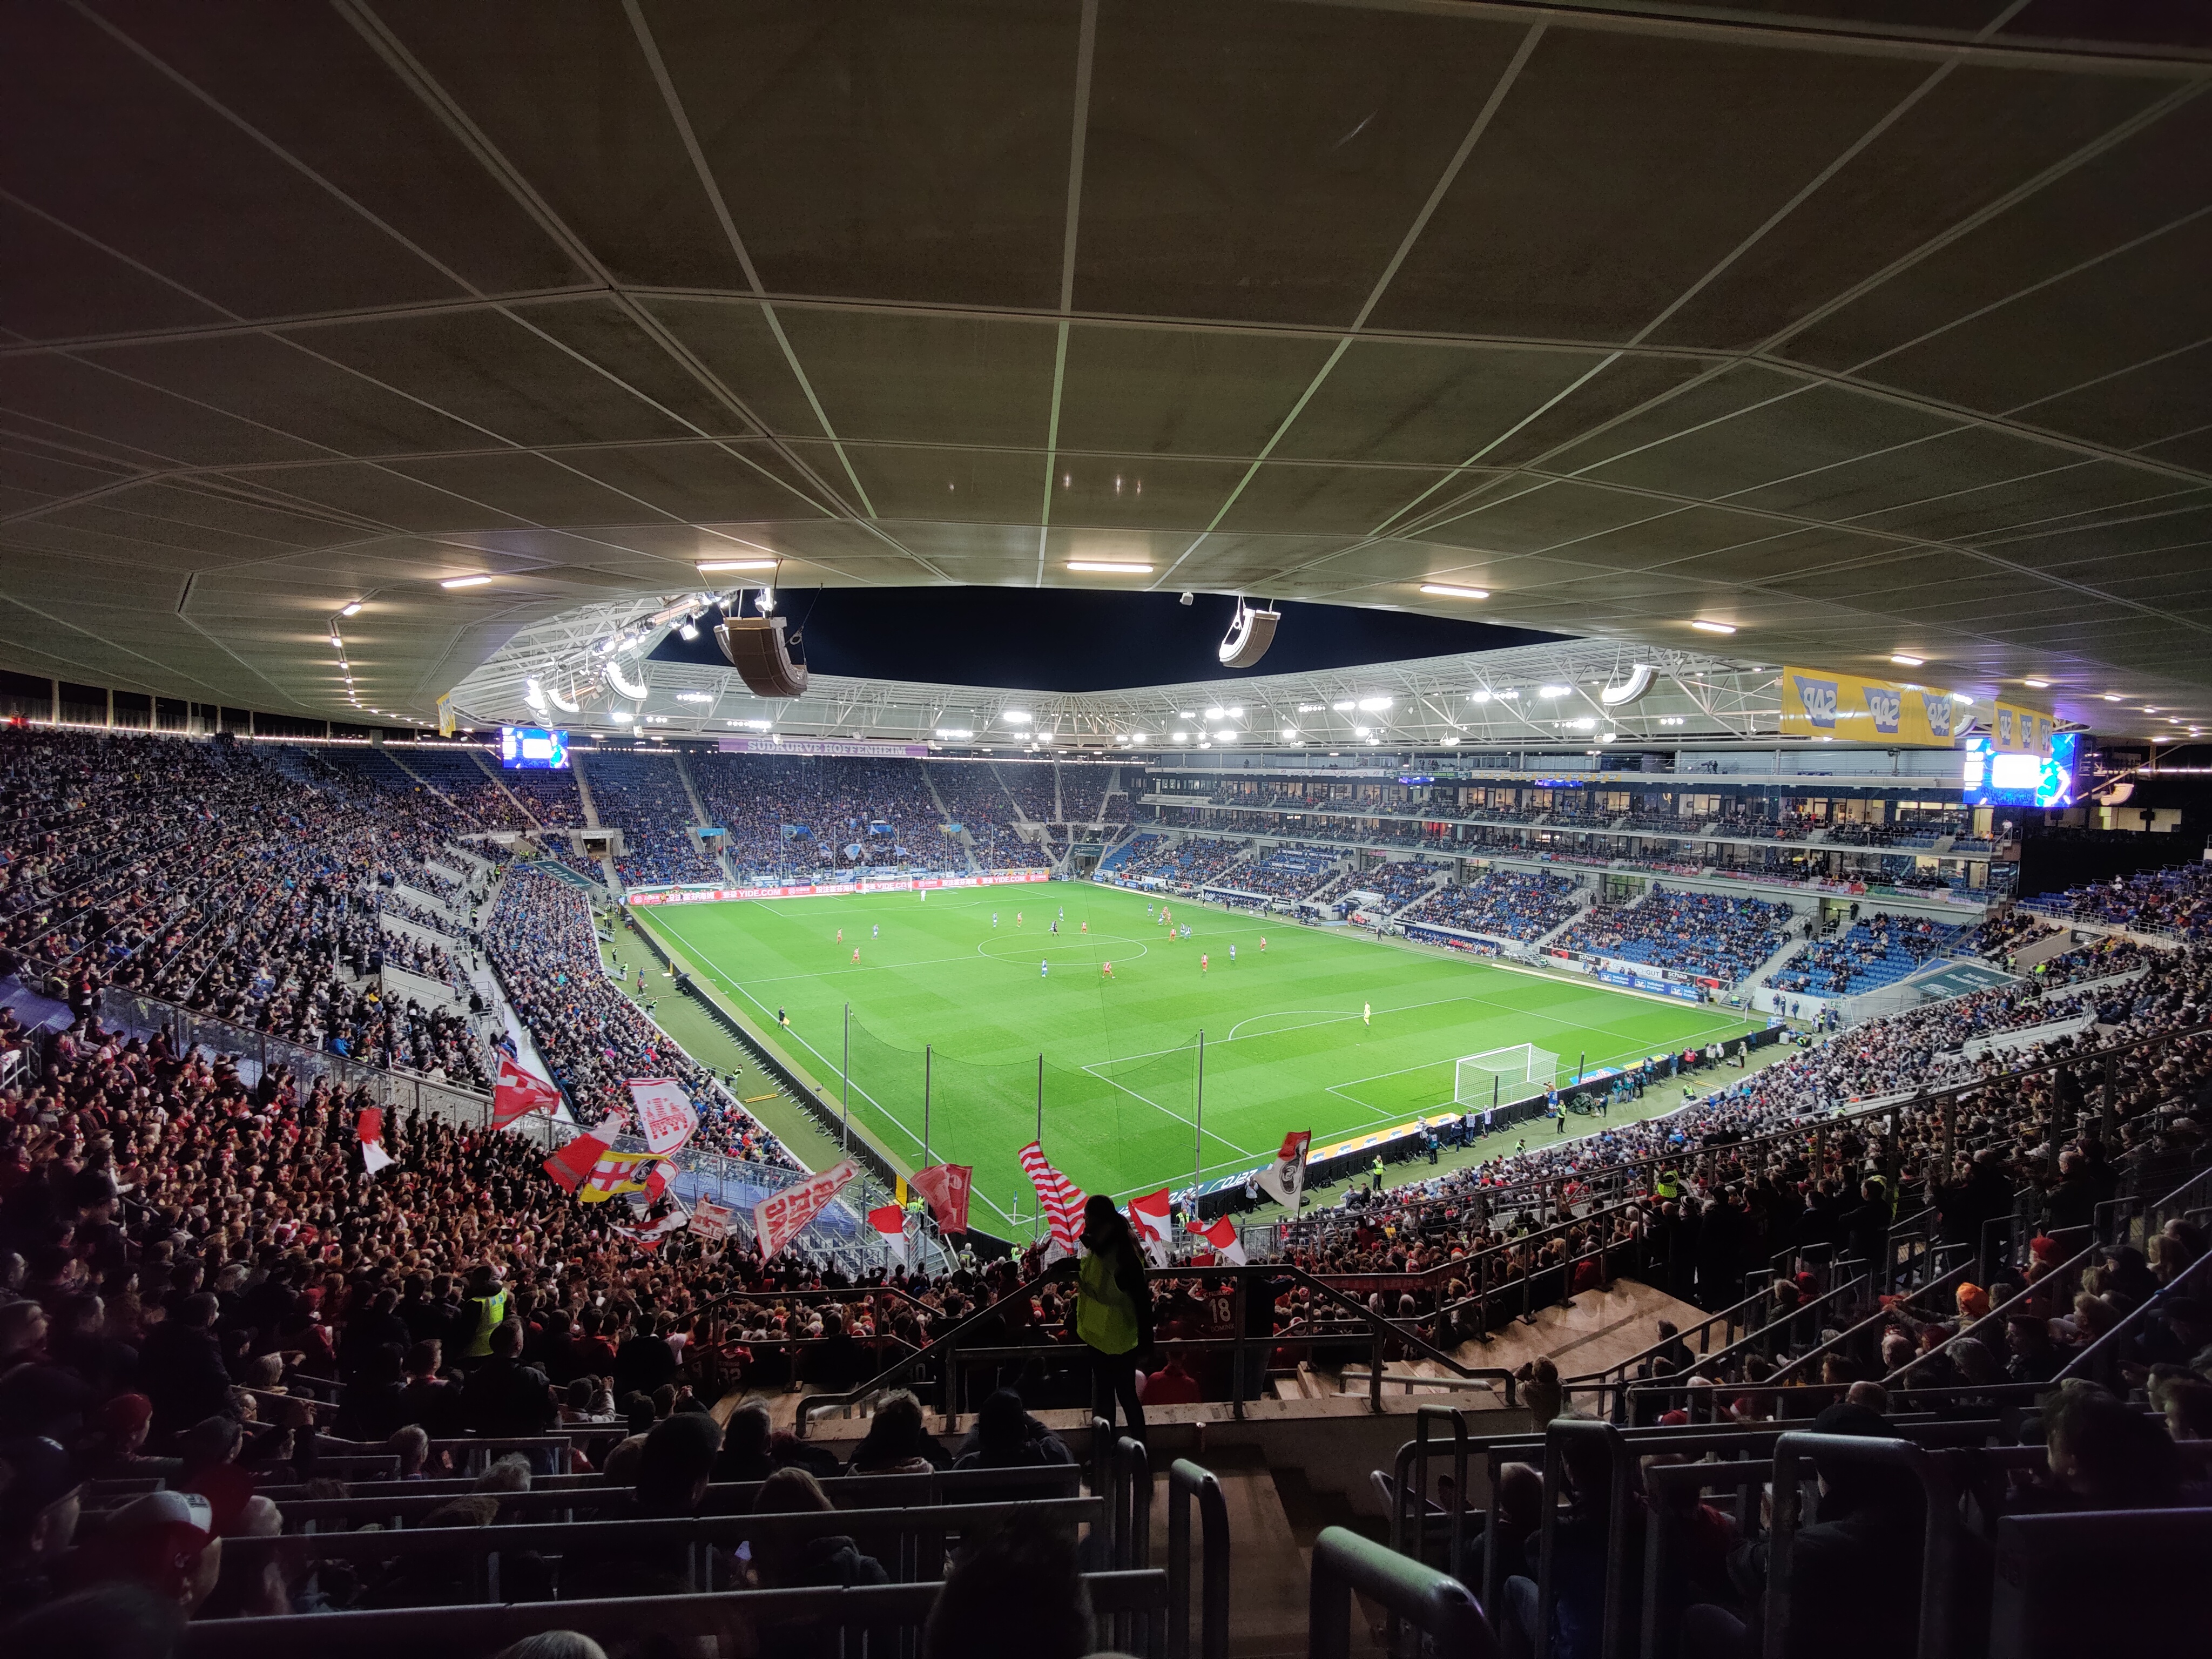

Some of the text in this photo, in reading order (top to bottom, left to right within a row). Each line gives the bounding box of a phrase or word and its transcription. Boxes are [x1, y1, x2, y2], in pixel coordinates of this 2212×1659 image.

[747, 739, 907, 755] SÜDKURVE HOFFENHEIM
[738, 889, 781, 898] YIDE.COM
[1579, 954, 1595, 962] schaa
[1668, 972, 1688, 980] schaa
[1209, 1298, 1231, 1324] 18
